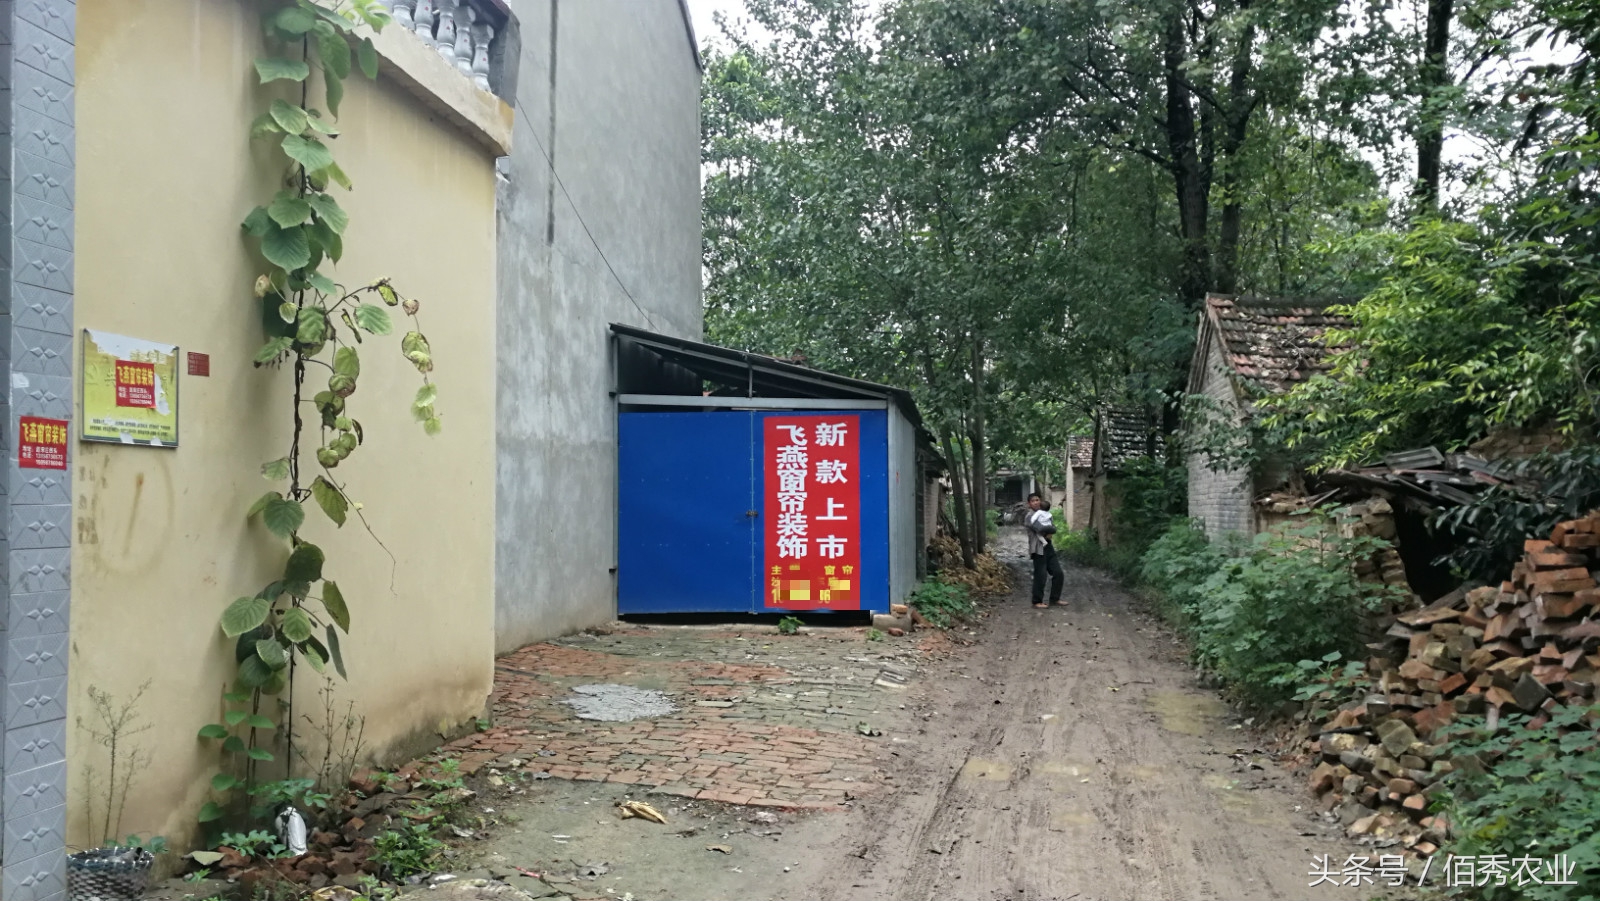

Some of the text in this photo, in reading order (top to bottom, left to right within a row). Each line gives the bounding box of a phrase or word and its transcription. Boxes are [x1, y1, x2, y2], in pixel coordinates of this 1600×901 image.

[22, 421, 67, 445] 飞燕窗帘装饰
[776, 424, 809, 560] 飞燕窗帘装饰
[815, 422, 848, 559] 新款上市
